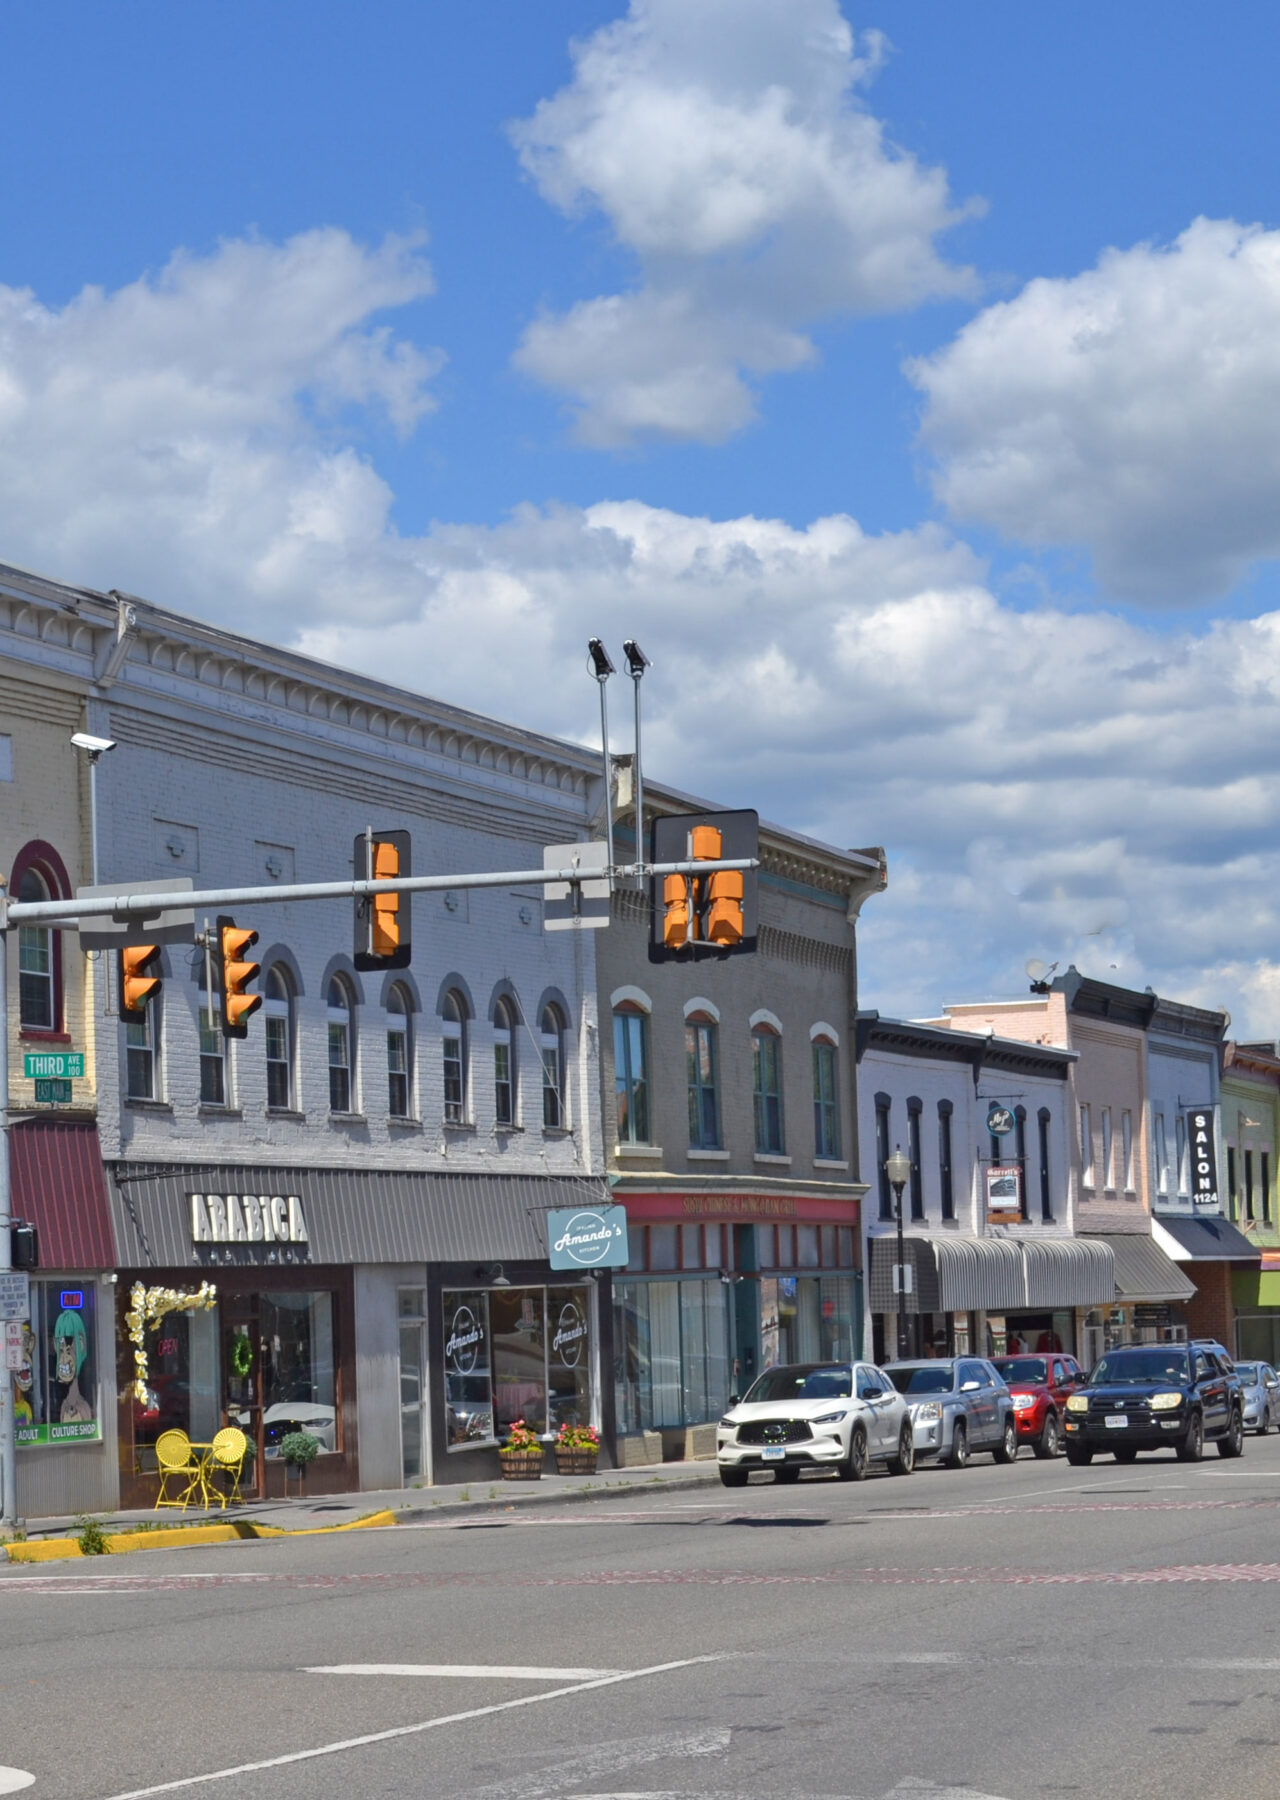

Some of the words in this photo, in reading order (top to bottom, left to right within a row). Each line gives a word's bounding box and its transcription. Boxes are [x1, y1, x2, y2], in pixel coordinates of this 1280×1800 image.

[28, 1056, 64, 1075] THIRD
[67, 1055, 80, 1065] AVE
[68, 1066, 80, 1076] 100
[37, 1081, 50, 1099] EAST
[1194, 1114, 1211, 1190] SALON
[1193, 1192, 1218, 1204] 1124
[192, 1194, 308, 1242] ARABICA
[554, 1224, 622, 1252] Amando's
[446, 1321, 484, 1357] Amando's
[553, 1319, 588, 1351] Amando's
[158, 1338, 179, 1357] OPEN
[18, 1429, 38, 1441] ADULT
[51, 1426, 79, 1438] CULTURE
[80, 1424, 96, 1436] SHOP
